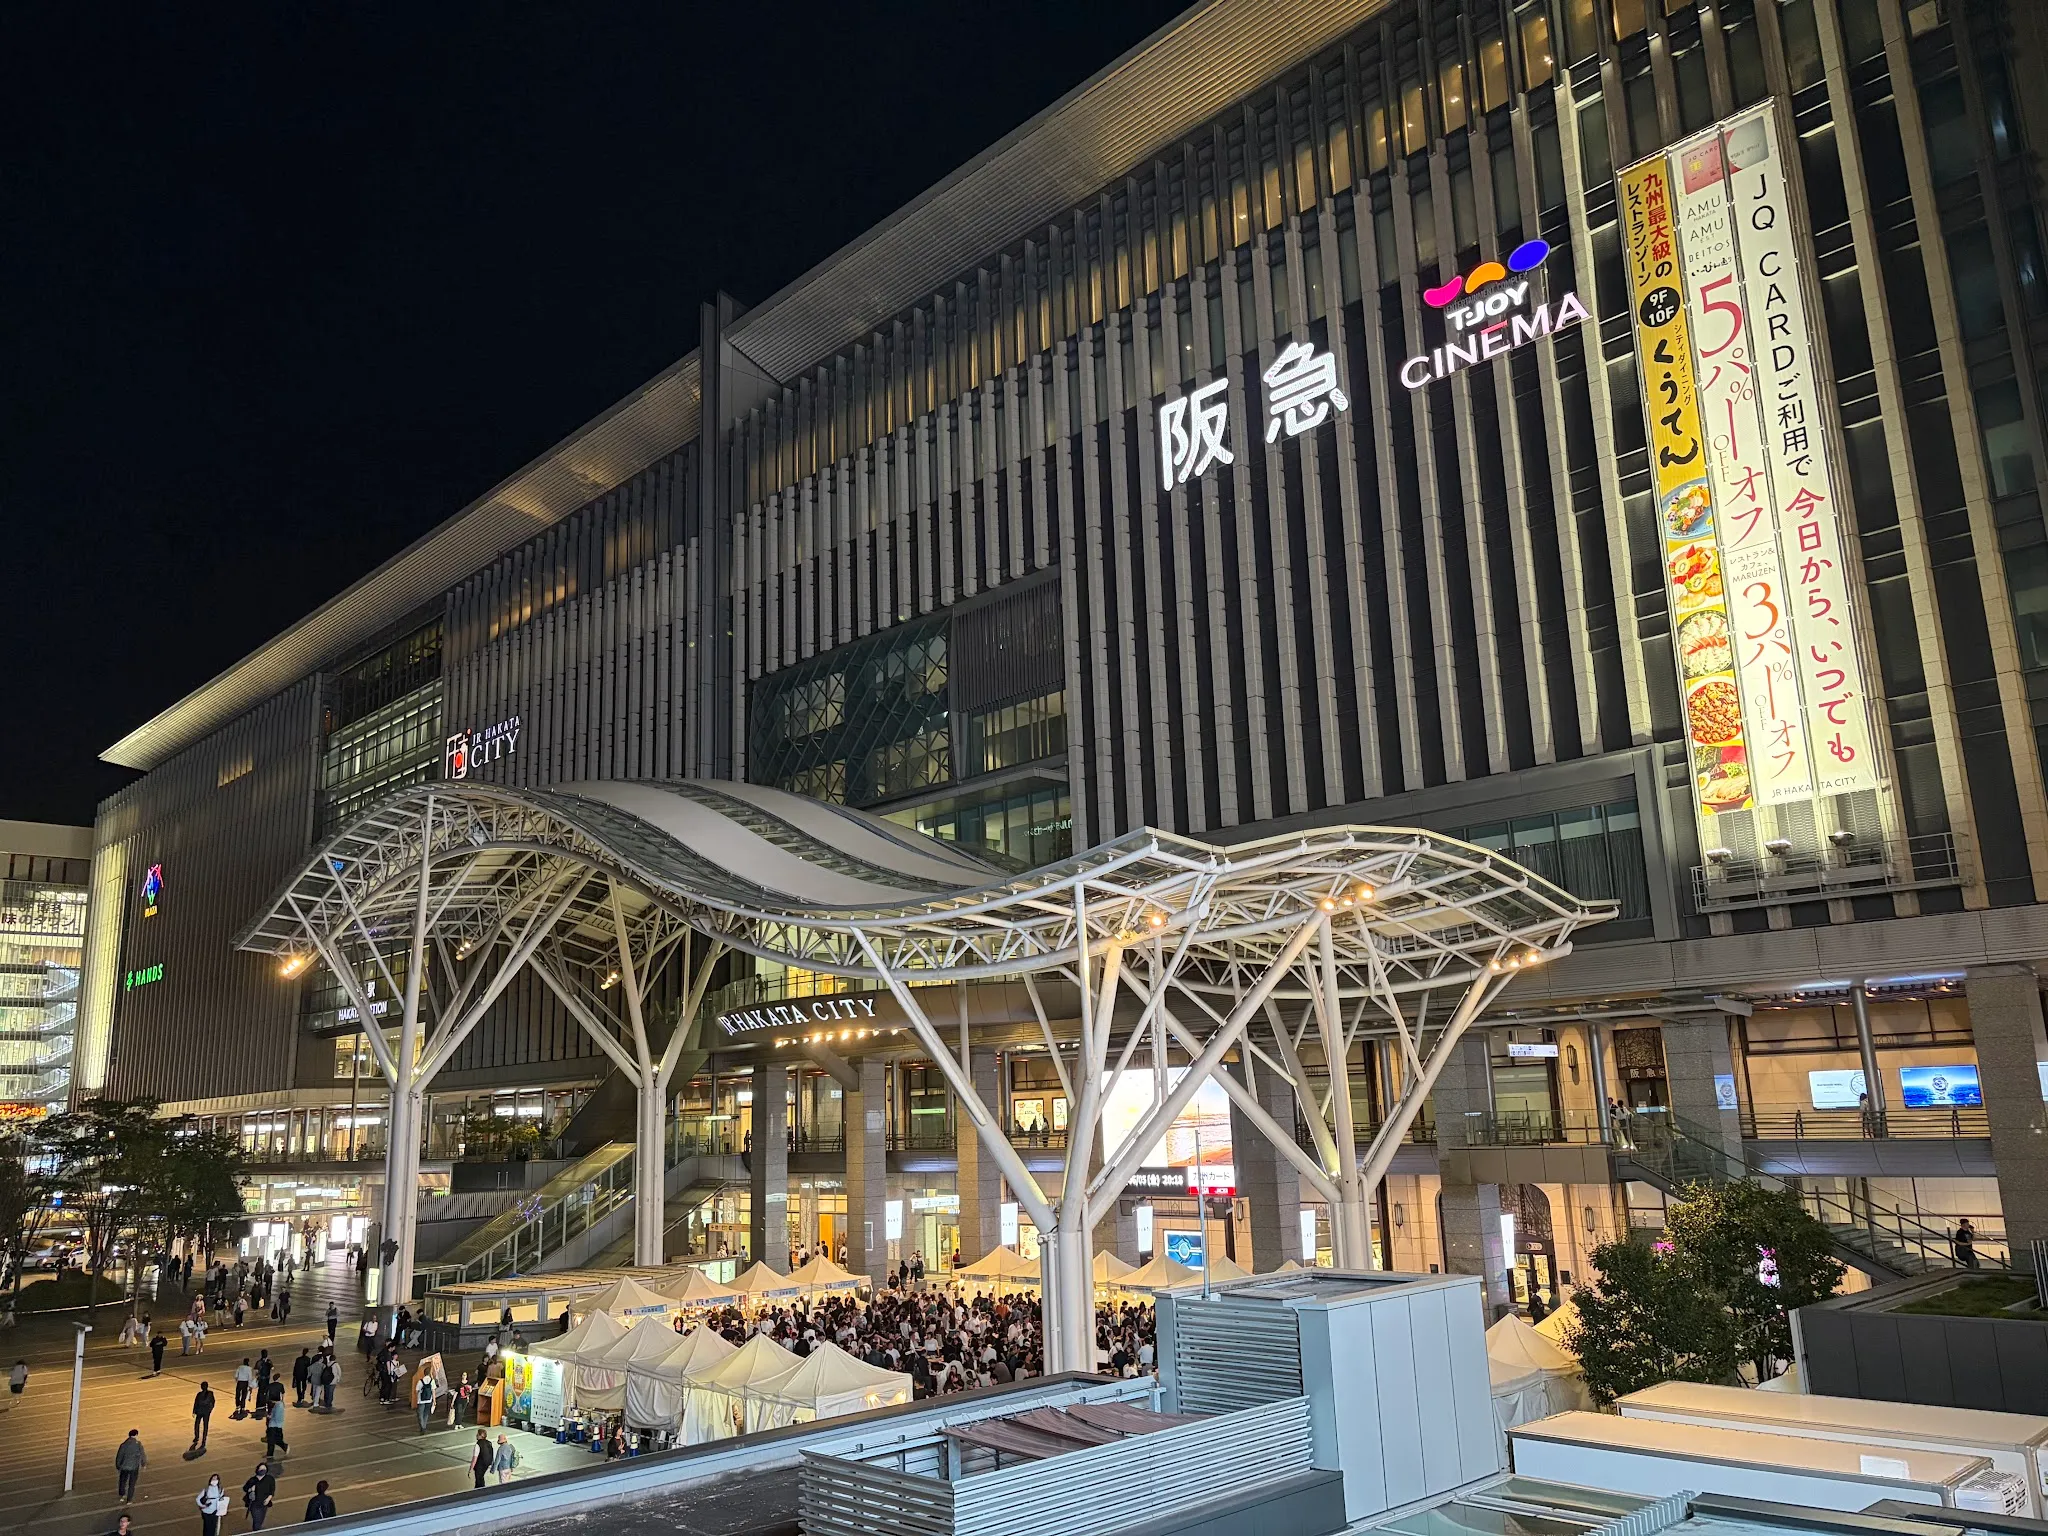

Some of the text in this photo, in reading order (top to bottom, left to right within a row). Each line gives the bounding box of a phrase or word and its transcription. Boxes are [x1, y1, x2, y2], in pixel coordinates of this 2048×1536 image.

[1687, 195, 1721, 220] AMU
[1628, 183, 1651, 287] レストランゾーン
[1643, 173, 1673, 278] 九州最大級の
[1690, 218, 1724, 242] AMU
[1688, 239, 1731, 263] DEITOS
[1445, 271, 1528, 313] ENTERTAINMENT COMPLEX
[1649, 289, 1668, 307] 9F
[1648, 305, 1675, 326] 10F
[1400, 292, 1592, 389] CINEMA
[1674, 324, 1692, 406] シティダイニング
[1160, 341, 1349, 491] 阪急
[1654, 338, 1699, 468] くうてん
[1714, 434, 1731, 484] OFF
[1730, 547, 1775, 565] レストラン&
[1732, 566, 1776, 584] MARUZEN
[1755, 694, 1767, 731] OFF
[471, 715, 521, 747] JR HAKATA
[471, 728, 520, 768] CITY
[1771, 775, 1857, 799] JR HAKATA CITY
[135, 962, 164, 987] HANDS
[338, 1008, 359, 1021] HAKAT
[718, 998, 876, 1036] JR HAKATA CITY
[1629, 1067, 1656, 1079] 阪急
